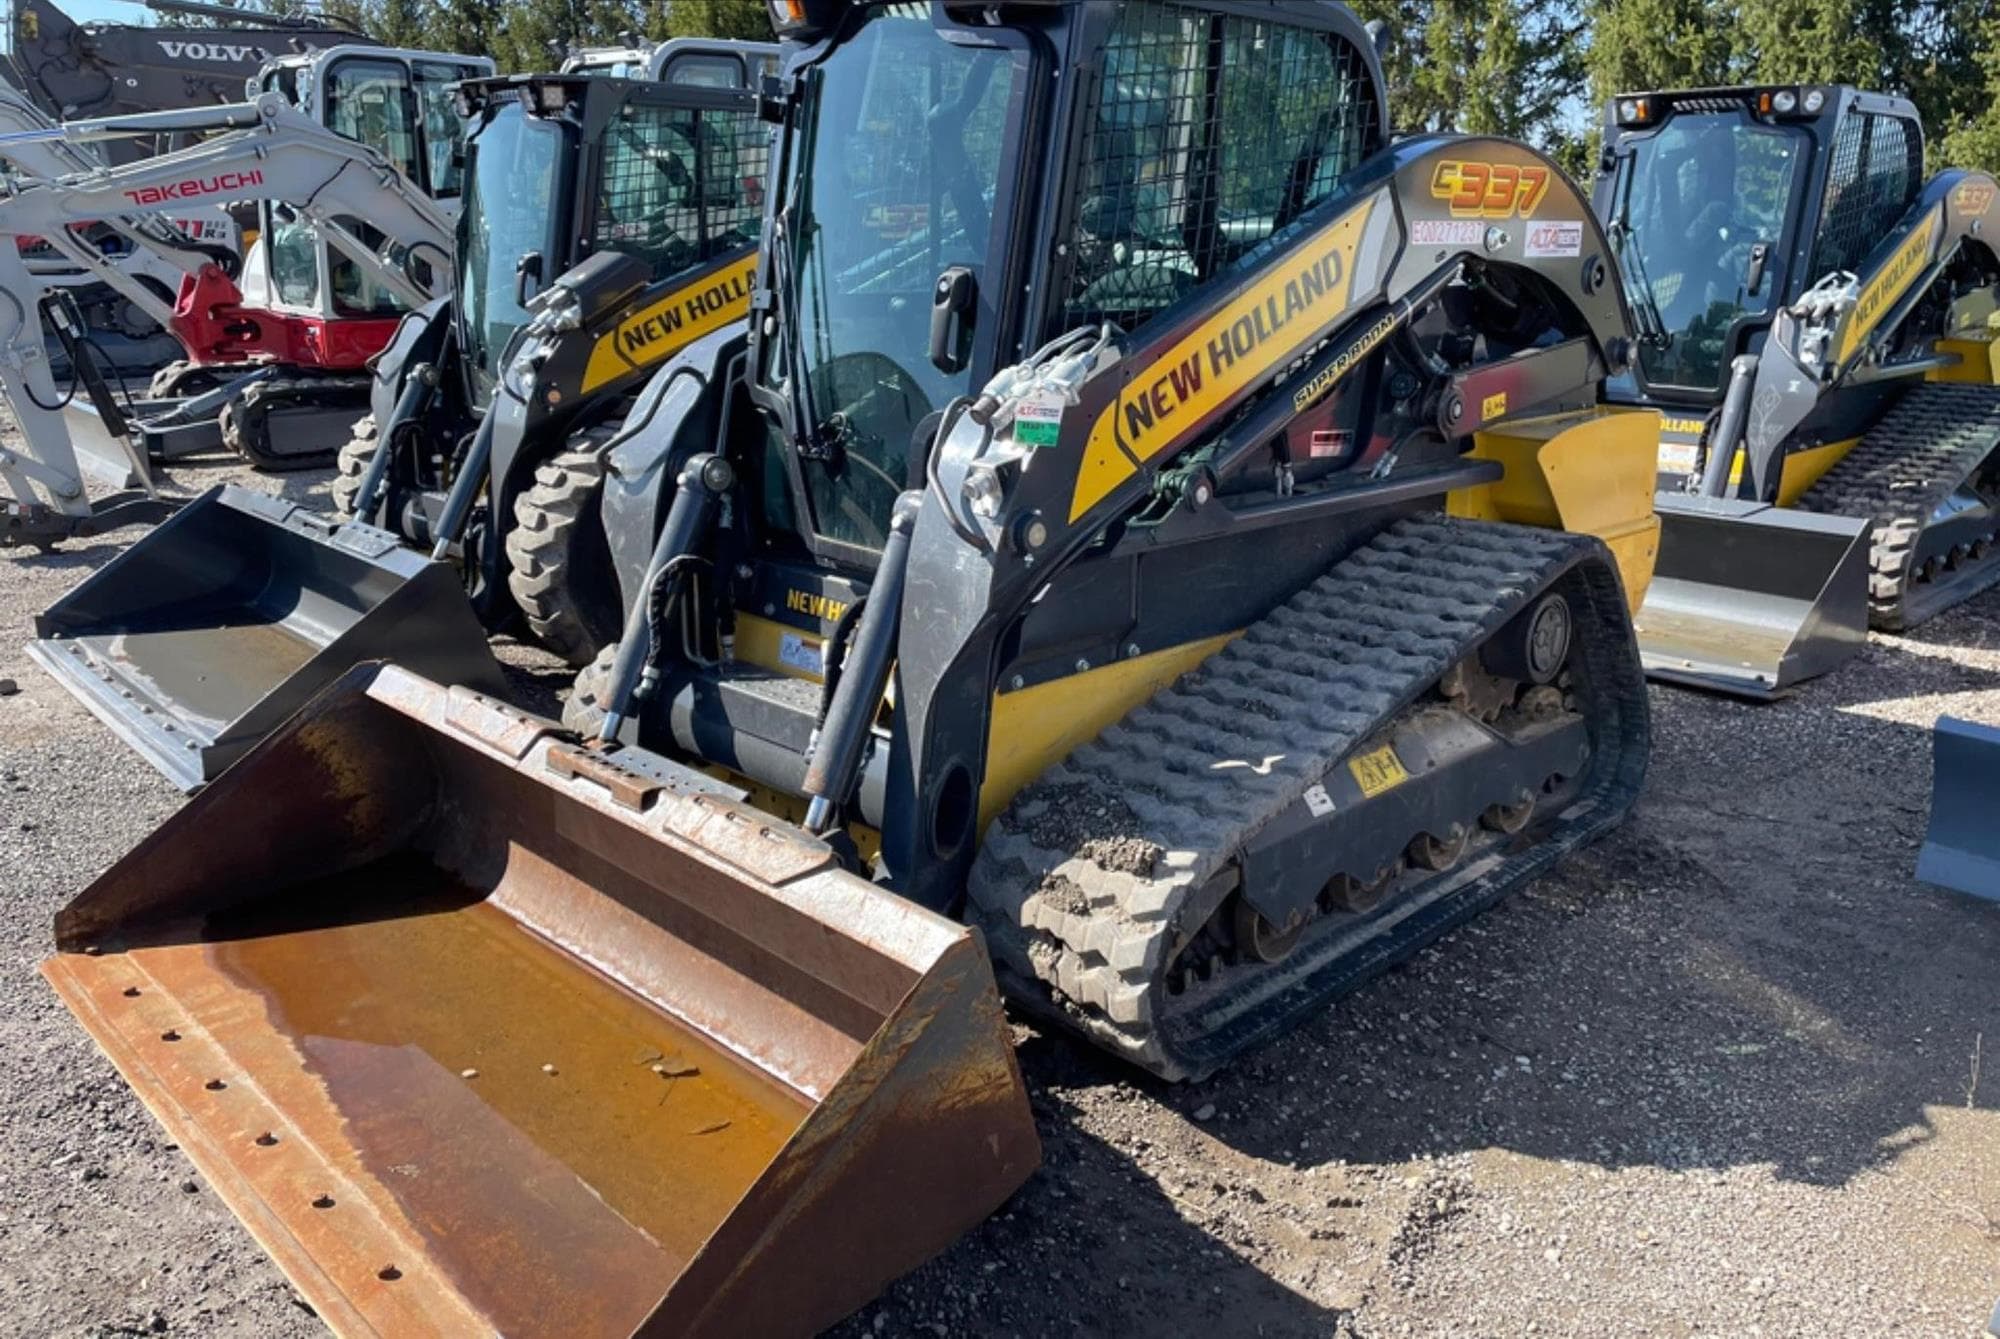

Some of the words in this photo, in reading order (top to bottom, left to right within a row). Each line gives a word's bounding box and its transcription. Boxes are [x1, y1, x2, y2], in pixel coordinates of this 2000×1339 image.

[157, 41, 262, 62] VOLV
[1856, 291, 1881, 326] NEW
[1881, 237, 1927, 299] HOLLAND
[624, 306, 682, 351] NEW
[1124, 352, 1202, 439] NEW
[1207, 249, 1343, 377] HOLLAND
[787, 588, 824, 616] NEW
